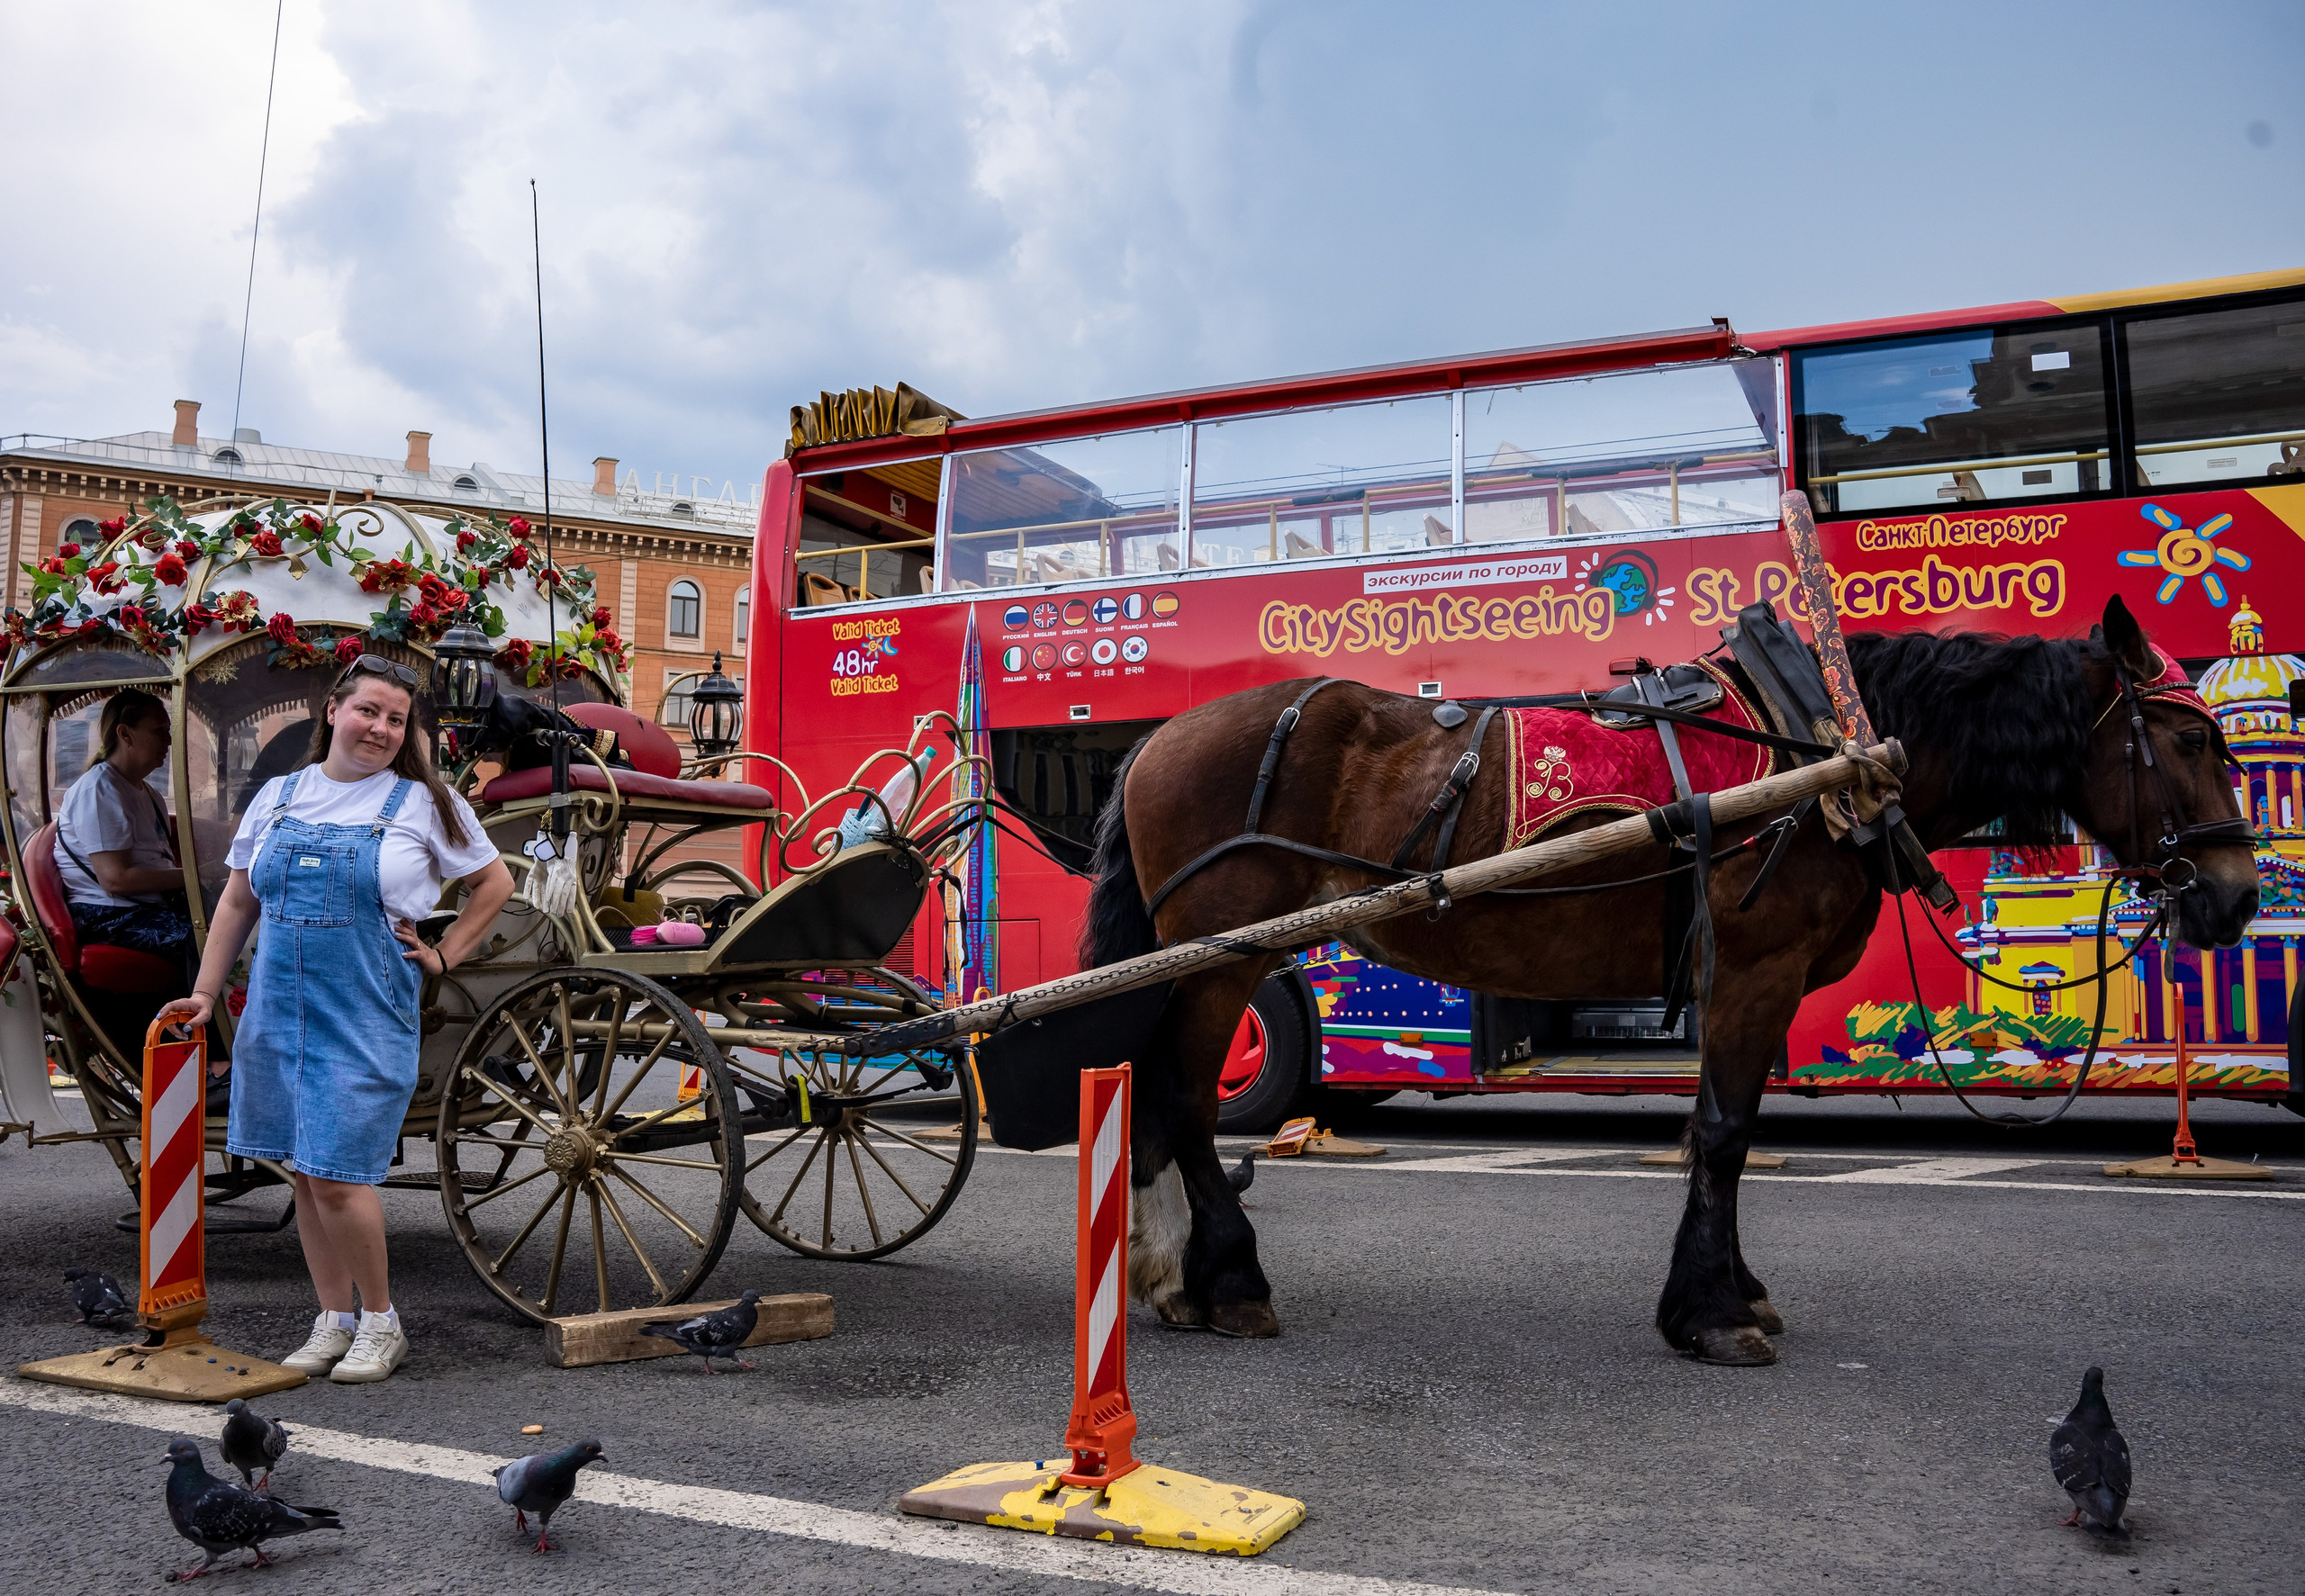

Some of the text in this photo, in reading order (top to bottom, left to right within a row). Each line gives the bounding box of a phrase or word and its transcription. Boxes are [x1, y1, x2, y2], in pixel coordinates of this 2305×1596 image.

[1857, 514, 2067, 551] Санкт-Петербург
[1368, 559, 1564, 588] экскурсии по городу
[1686, 555, 2065, 626] St Peersburg
[1120, 623, 1149, 631] FRANÇAIS
[1152, 620, 1179, 629] ESPAÑOL
[1259, 585, 1615, 657] CitySightseeing
[832, 618, 901, 641] Valid Ticket
[1002, 631, 1030, 640] РУССКИЙ
[1036, 672, 1052, 681] 中文
[1093, 669, 1115, 678] 日本語
[1125, 666, 1144, 675] 한국어
[830, 673, 899, 697] Valid Ticket
